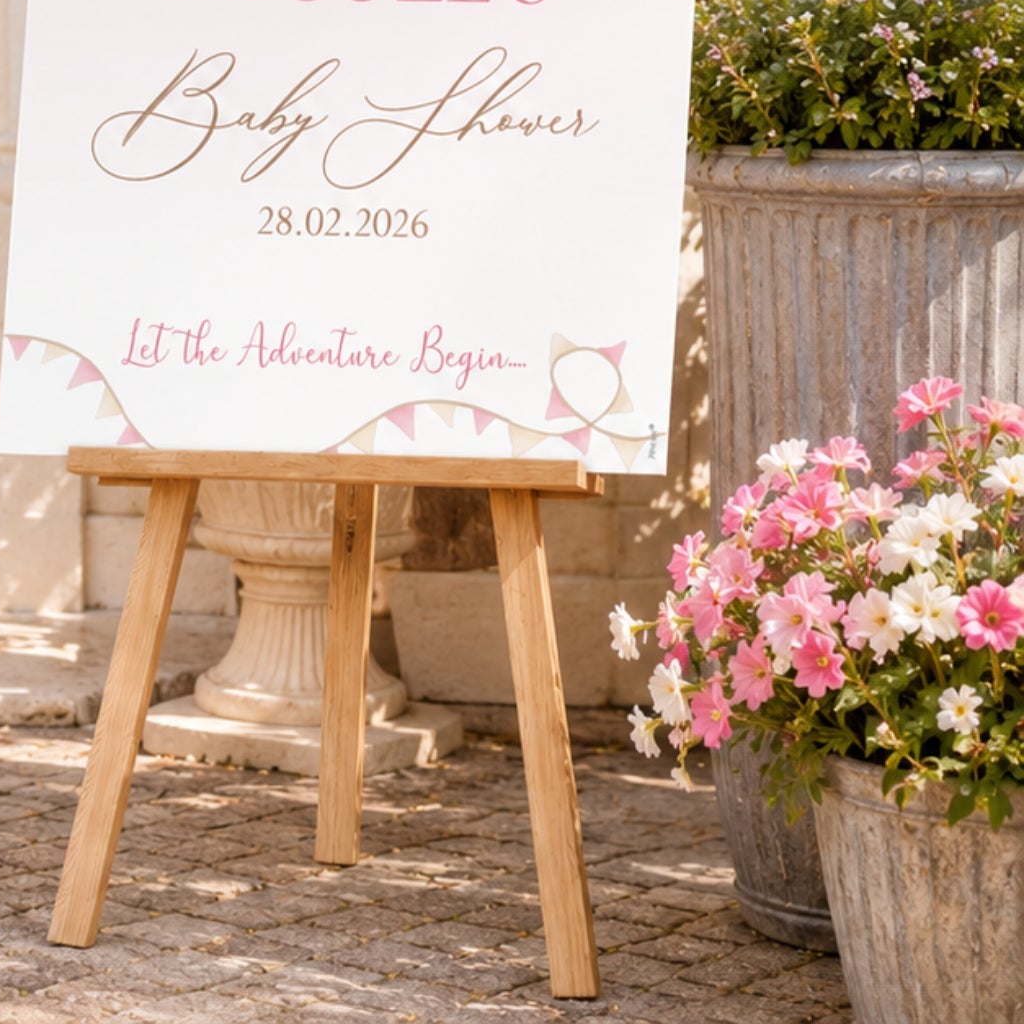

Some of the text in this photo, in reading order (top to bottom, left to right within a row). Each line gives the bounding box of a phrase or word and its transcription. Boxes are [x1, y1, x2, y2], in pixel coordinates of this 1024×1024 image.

[91, 47, 600, 191] Baby Shower
[257, 205, 429, 239] 28.02.2026
[121, 317, 175, 368] Let
[171, 318, 228, 366] the
[236, 320, 401, 370] Adventure
